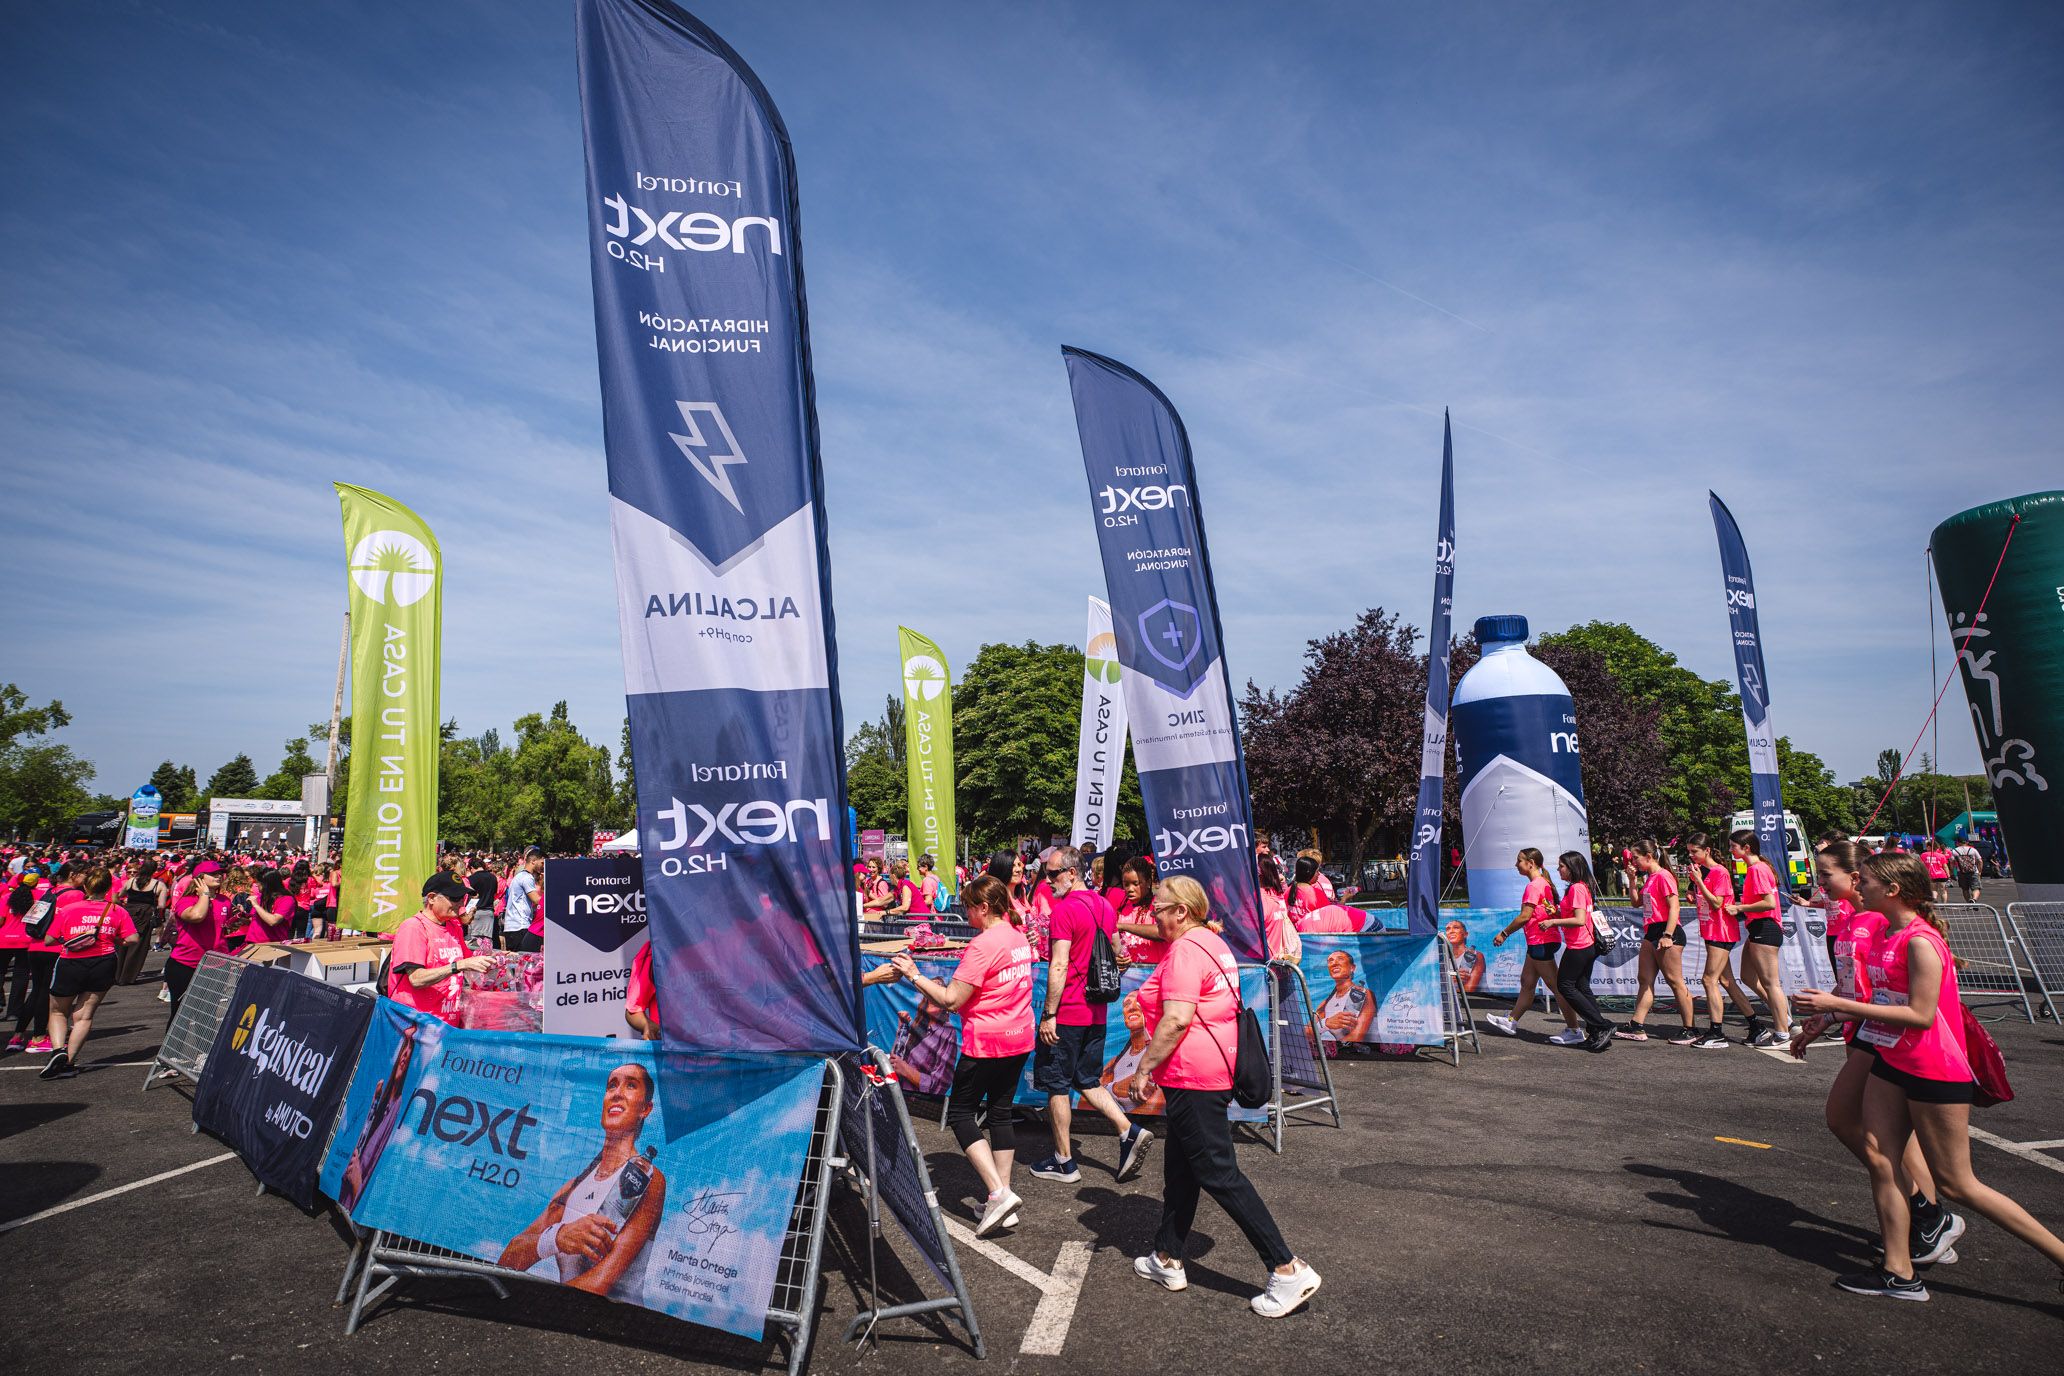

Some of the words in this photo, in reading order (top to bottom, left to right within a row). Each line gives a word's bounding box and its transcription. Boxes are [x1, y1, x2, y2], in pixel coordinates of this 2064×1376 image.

[585, 876, 631, 886] Fontarel
[568, 889, 647, 915] next
[620, 914, 647, 924] H2.0
[556, 971, 577, 985] La
[581, 968, 632, 983] nueva
[556, 992, 579, 1006] de
[583, 990, 598, 1005] la
[440, 1049, 524, 1085] Fontarel
[397, 1087, 538, 1161] next
[467, 1158, 521, 1189] H2.0
[668, 1249, 699, 1267] Marta
[700, 1258, 738, 1279] Ortega
